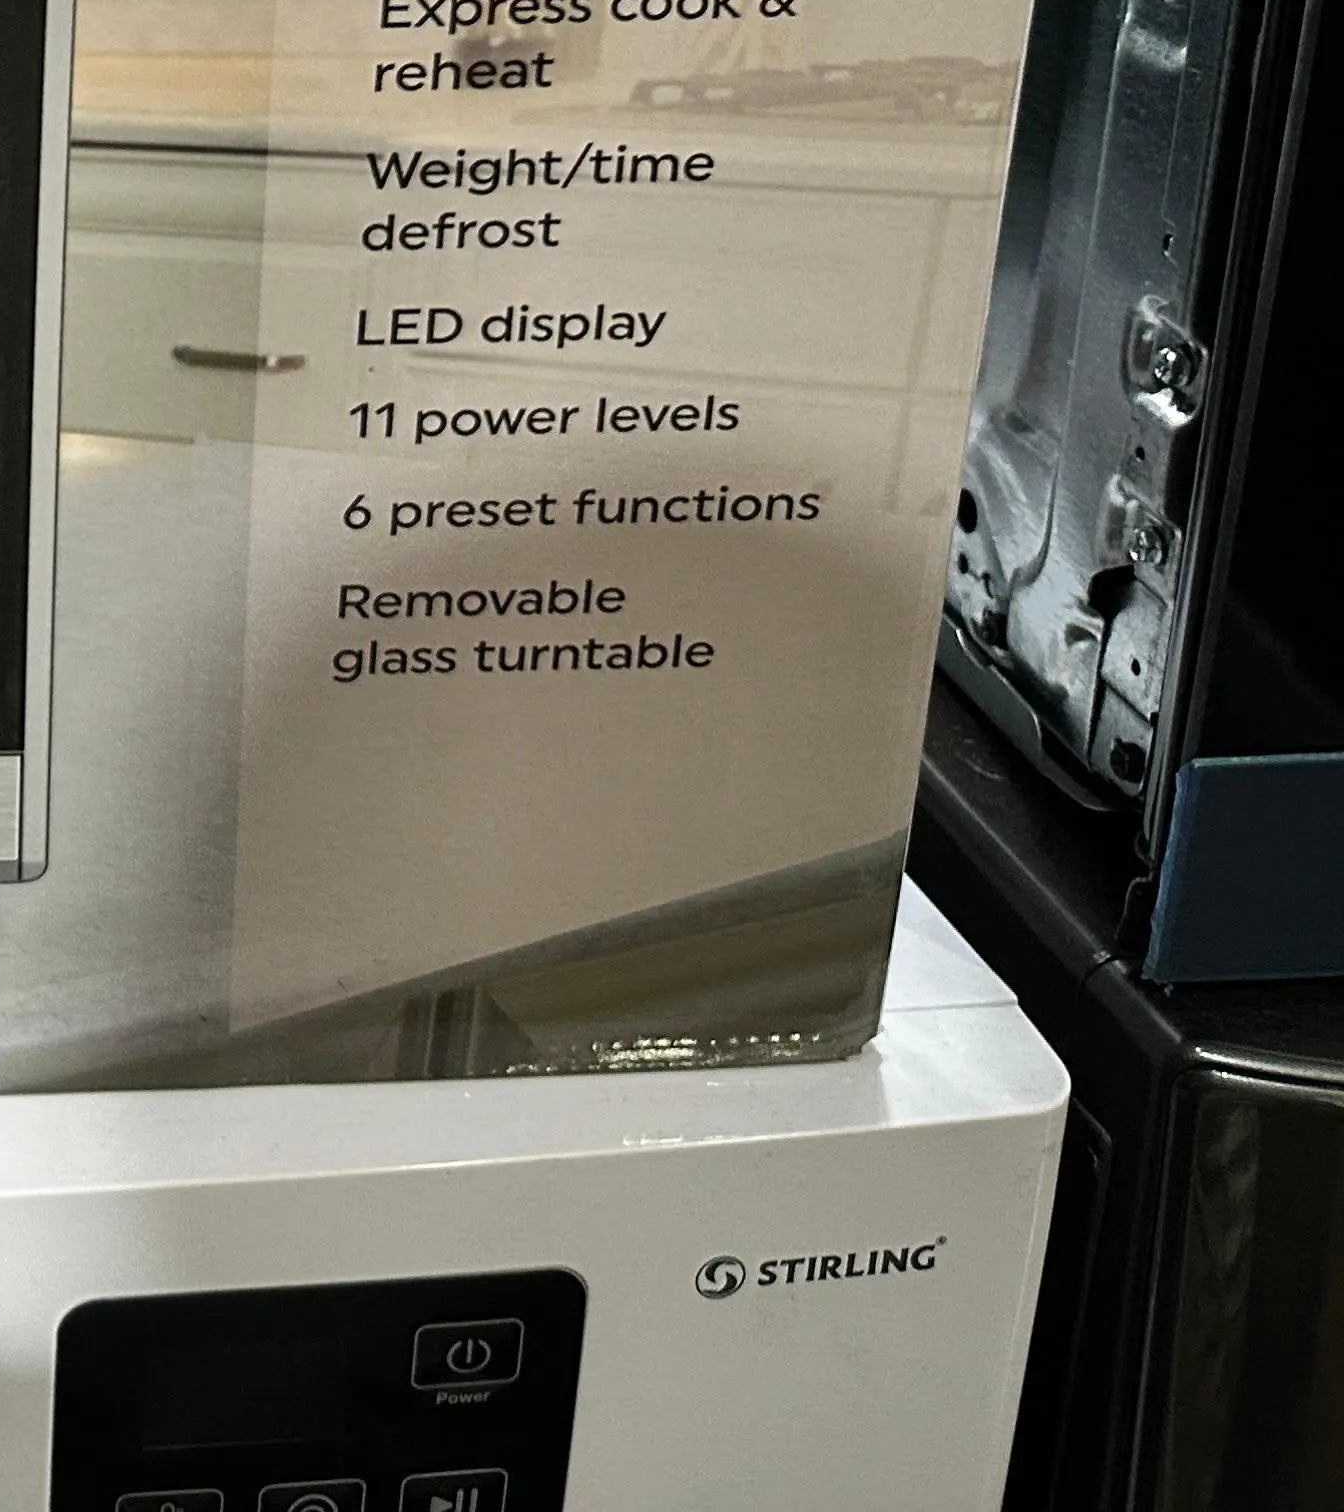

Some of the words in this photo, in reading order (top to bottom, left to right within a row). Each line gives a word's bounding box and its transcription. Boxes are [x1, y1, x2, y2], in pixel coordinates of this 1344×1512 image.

[373, 52, 554, 92] reheat
[365, 141, 715, 196] Weight/time
[361, 211, 561, 252] defrost
[356, 307, 463, 346] LED
[480, 304, 667, 349] display
[348, 402, 396, 439] 11
[414, 403, 579, 445] power
[596, 394, 740, 433] levels
[342, 494, 372, 530] 6
[389, 491, 557, 536] preset
[573, 485, 821, 525] functions
[337, 578, 626, 618] Removable
[332, 639, 457, 682] glass
[473, 634, 715, 673] turntable
[436, 1391, 491, 1405] Power
